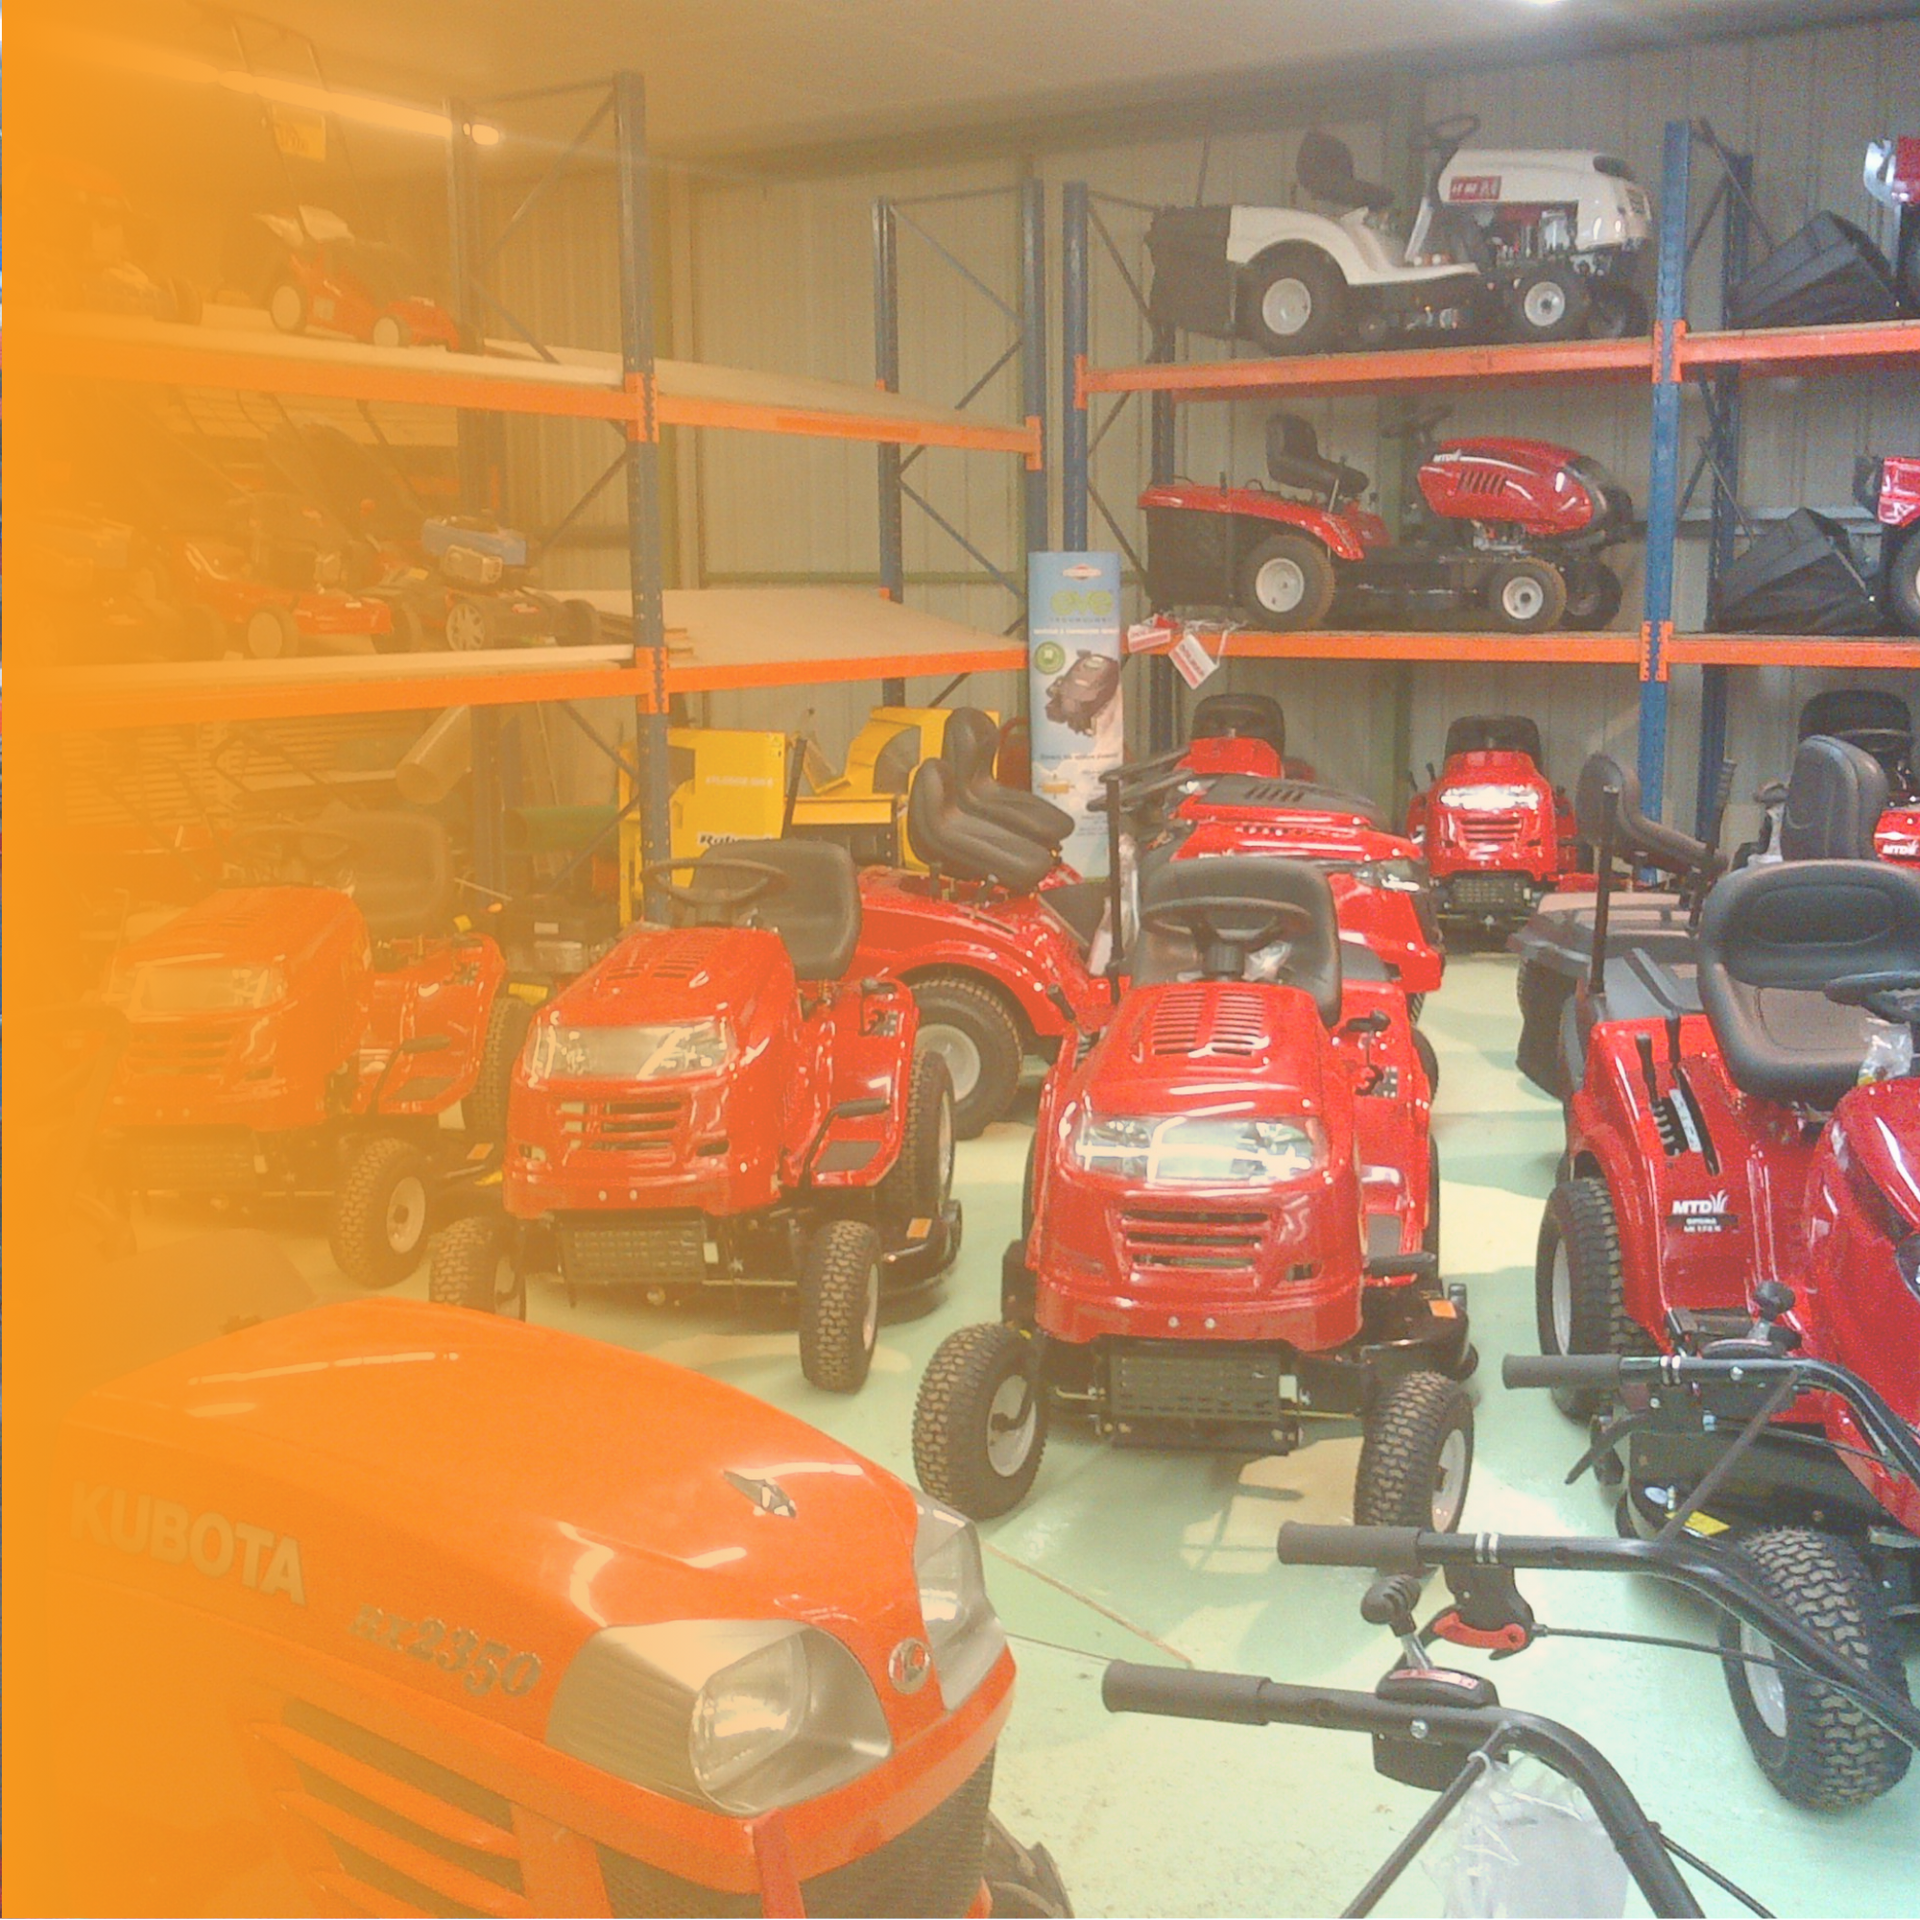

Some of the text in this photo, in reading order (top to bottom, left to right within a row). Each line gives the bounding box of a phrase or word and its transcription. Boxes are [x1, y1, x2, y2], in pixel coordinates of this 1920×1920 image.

[1049, 590, 1113, 616] eve
[1882, 844, 1908, 856] MTD
[1672, 1199, 1713, 1215] MTD
[70, 1479, 308, 1608] KUBOTA
[347, 1601, 543, 1697] RX2350
